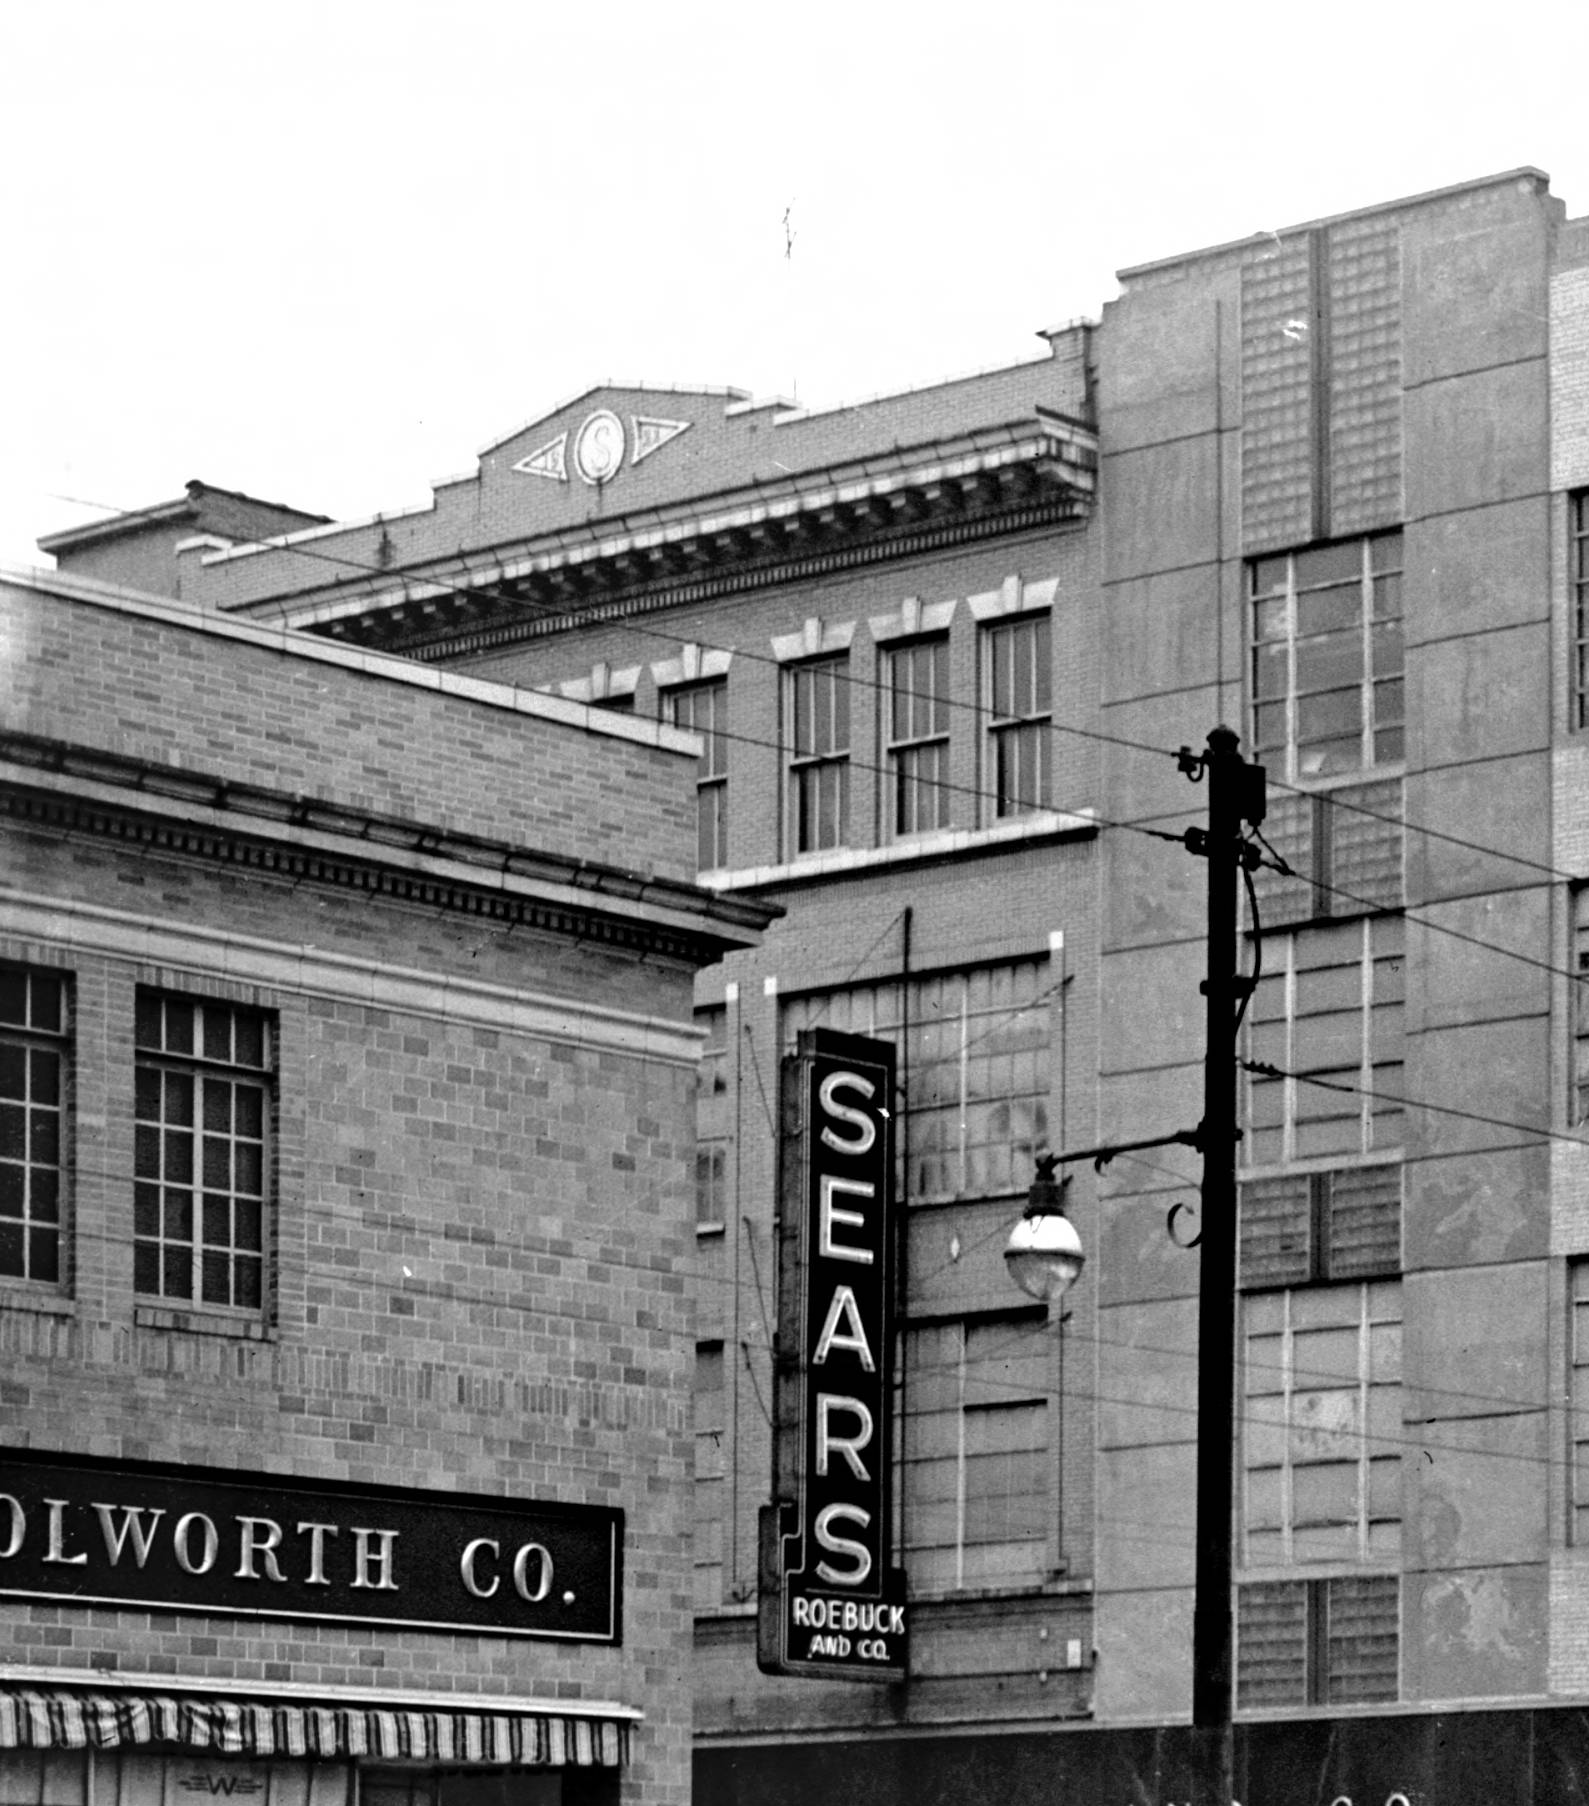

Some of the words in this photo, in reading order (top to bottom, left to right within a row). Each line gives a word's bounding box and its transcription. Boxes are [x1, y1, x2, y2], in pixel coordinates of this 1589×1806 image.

[812, 1070, 877, 1587] SEARS
[460, 1537, 576, 1604] CO.
[792, 1595, 906, 1635] ROEBUCK
[809, 1634, 851, 1657] AND
[206, 1773, 238, 1796] W
